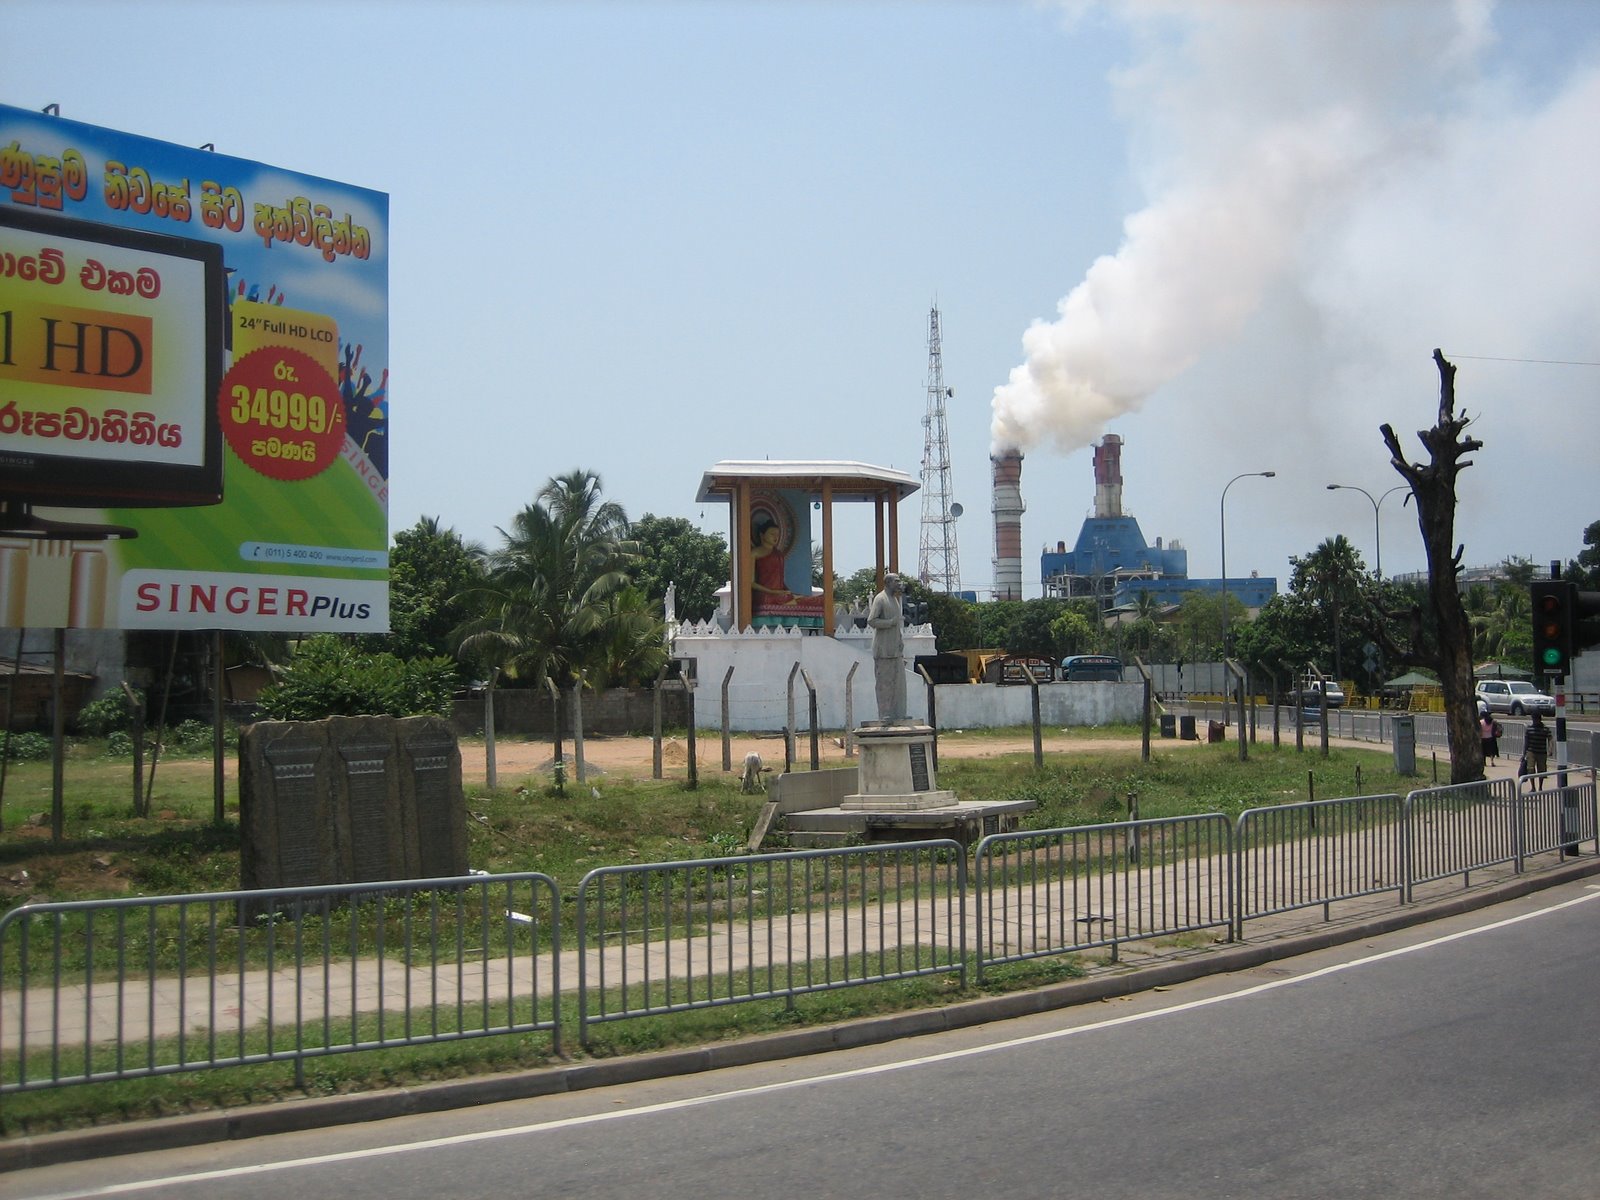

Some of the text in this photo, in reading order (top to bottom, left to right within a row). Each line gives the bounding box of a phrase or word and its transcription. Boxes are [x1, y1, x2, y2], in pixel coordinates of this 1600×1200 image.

[201, 180, 245, 233] සිට
[80, 258, 161, 299] එකම
[40, 317, 144, 378] HD
[263, 320, 286, 335] Full
[289, 325, 308, 338] HD
[310, 329, 333, 343] LCD
[231, 385, 342, 434] 34999/=
[251, 437, 316, 462] පමණයි
[265, 547, 285, 559] (011)
[286, 548, 292, 558] 5
[293, 549, 307, 559] 400
[308, 551, 323, 560] 400
